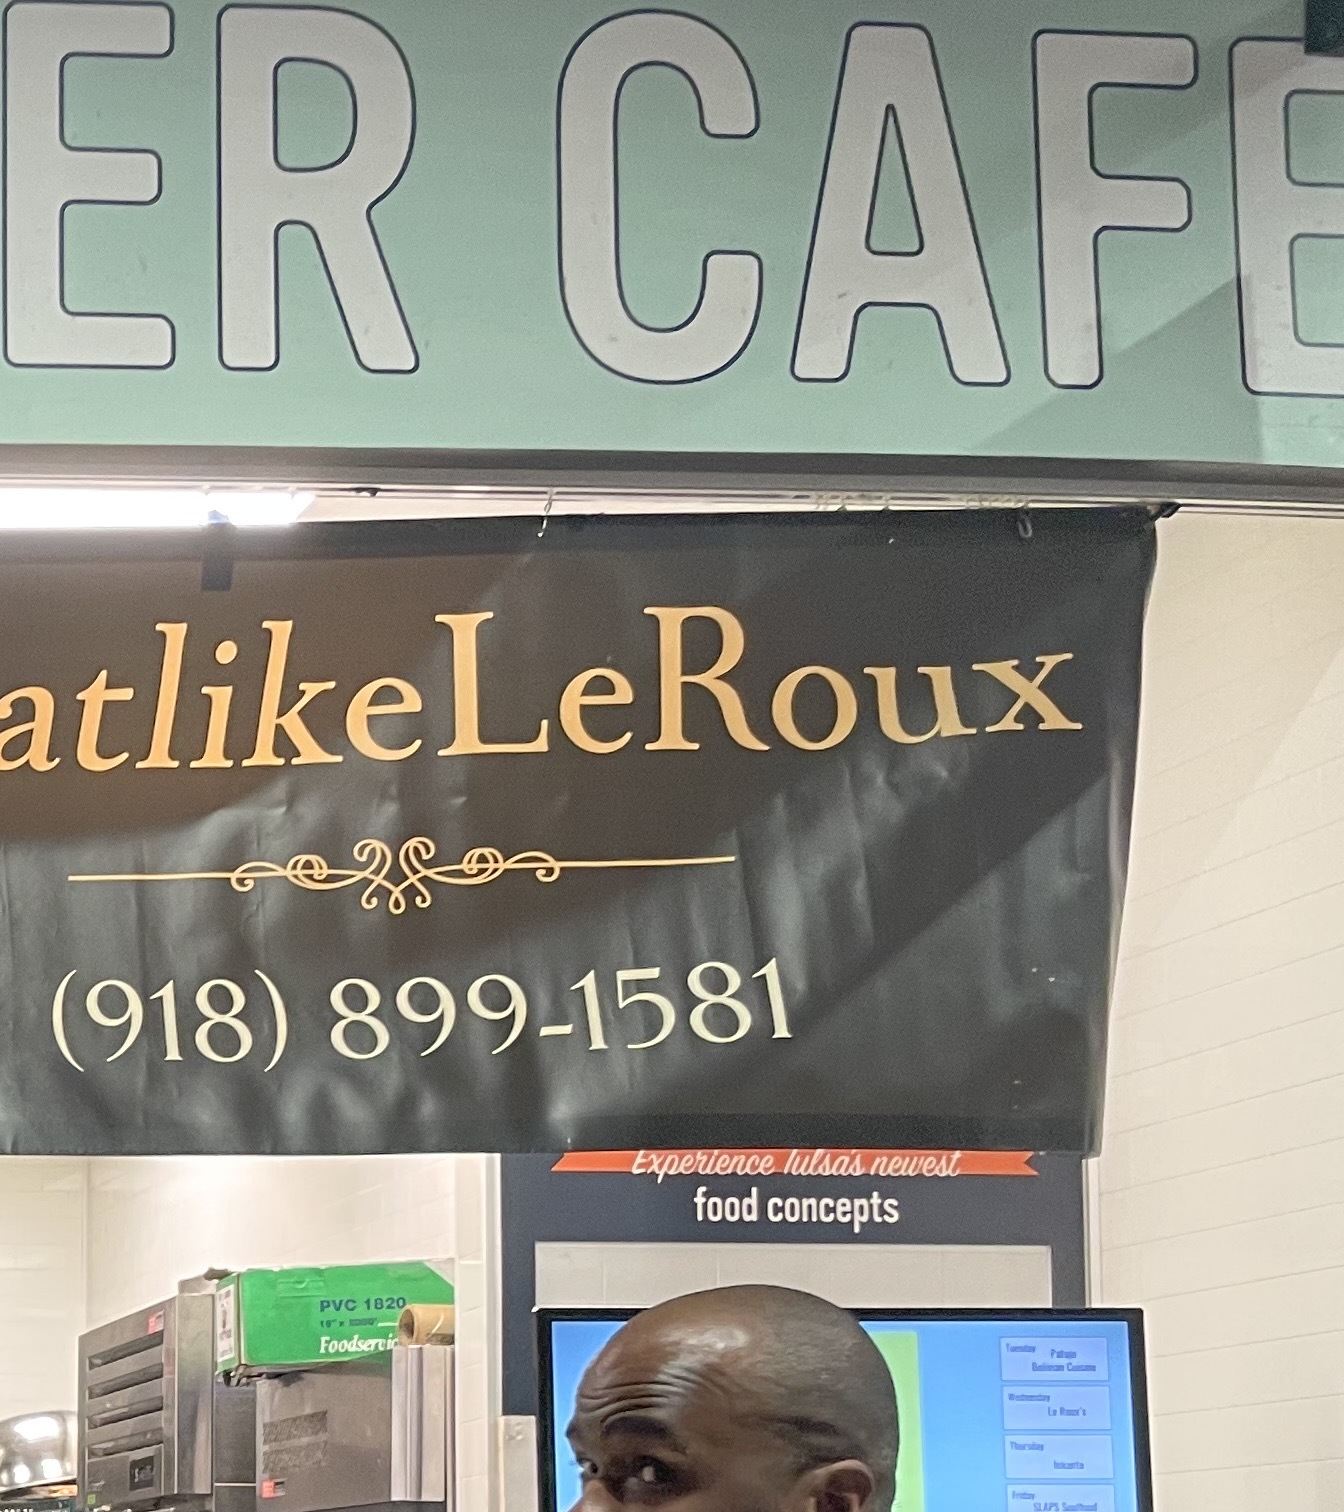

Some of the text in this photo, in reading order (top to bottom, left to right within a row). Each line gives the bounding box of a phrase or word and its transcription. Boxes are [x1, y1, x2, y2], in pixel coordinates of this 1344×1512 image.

[51, 957, 793, 1073] (918) 899-1581
[631, 1149, 775, 1184] Experience
[870, 1150, 962, 1177] newest
[693, 1186, 900, 1234] food concepts
[319, 1296, 408, 1313] PVC 1820
